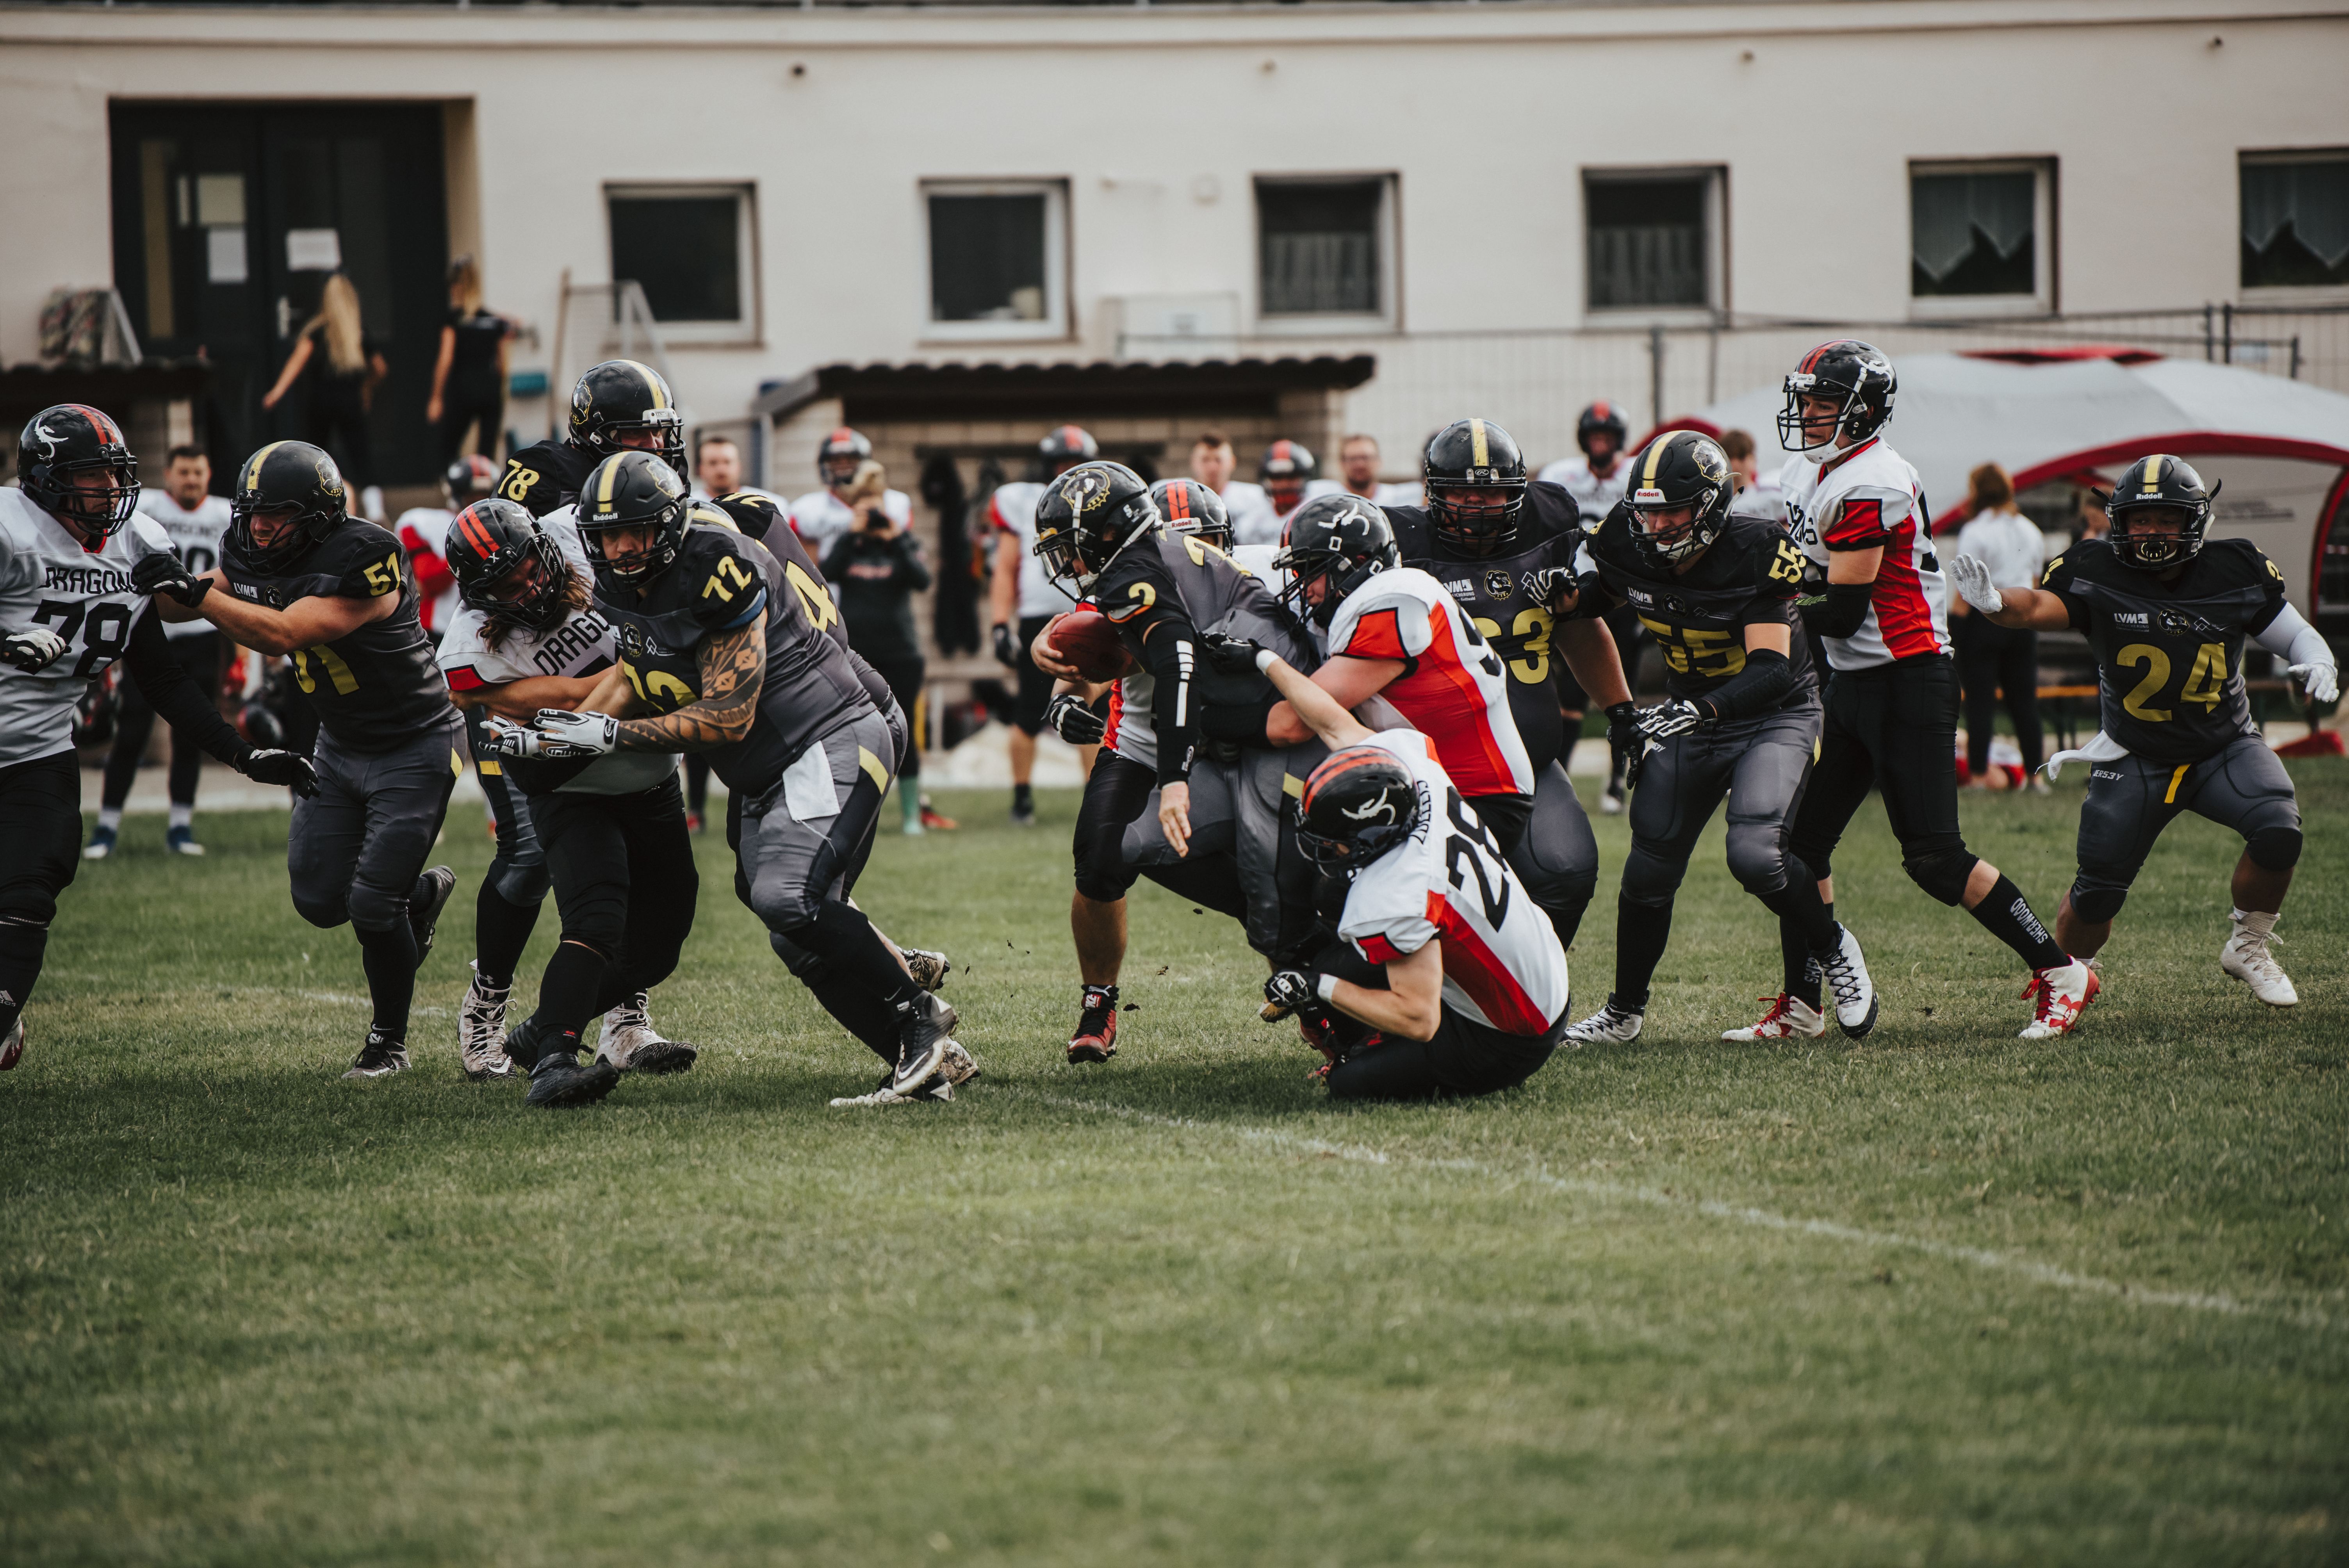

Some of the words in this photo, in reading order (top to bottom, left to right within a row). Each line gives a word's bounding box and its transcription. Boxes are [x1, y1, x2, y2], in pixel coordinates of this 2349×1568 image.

[497, 458, 540, 501] 78
[593, 512, 618, 521] Riddell
[1171, 519, 1192, 528] Riddell
[363, 551, 401, 596] 51
[702, 556, 752, 602] 72
[1128, 582, 1156, 606] 2
[1443, 580, 1463, 593] VM
[15, 599, 133, 681] 78
[2114, 613, 2137, 624] LVM
[1470, 608, 1555, 684] 3
[2116, 642, 2228, 722] 24
[2093, 769, 2124, 780] JERS3Y
[1446, 785, 1510, 933] 28
